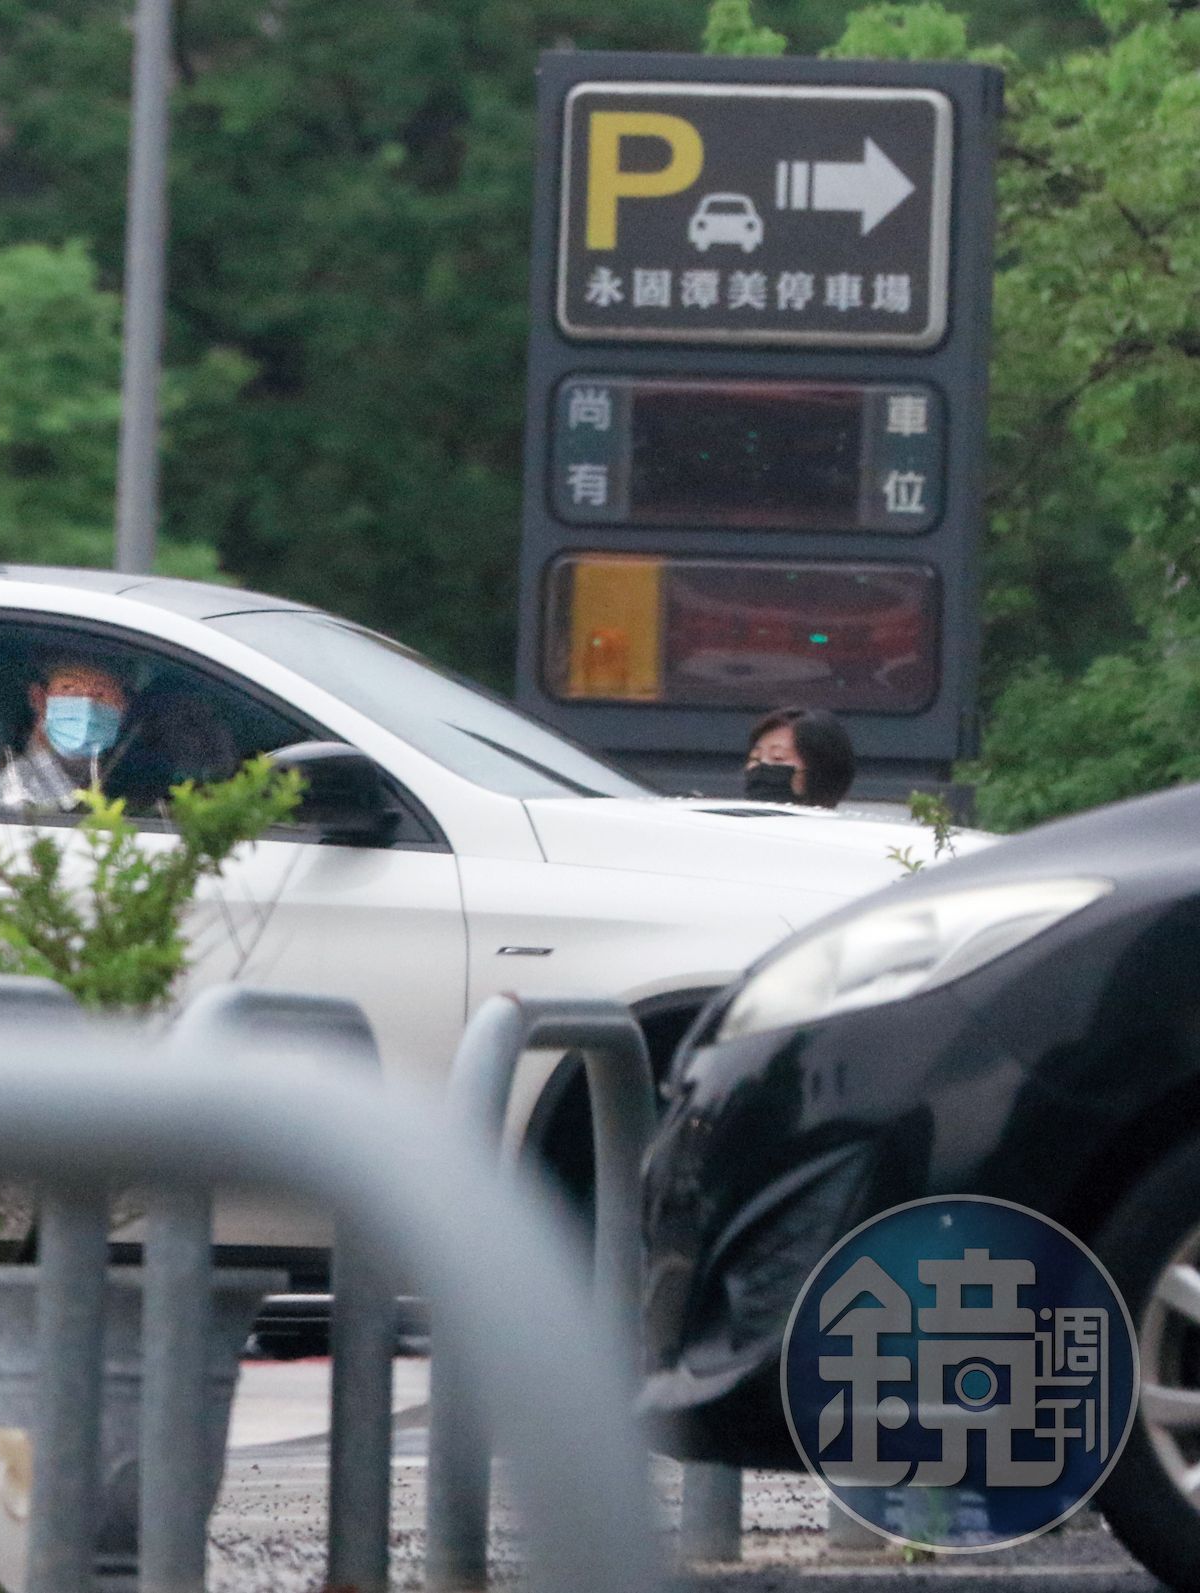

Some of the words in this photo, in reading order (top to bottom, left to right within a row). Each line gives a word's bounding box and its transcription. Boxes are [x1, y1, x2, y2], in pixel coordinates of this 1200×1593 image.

[586, 111, 705, 250] P
[586, 267, 912, 314] 永固潭美停車場
[567, 388, 611, 506] 尚有
[883, 396, 926, 513] 車位
